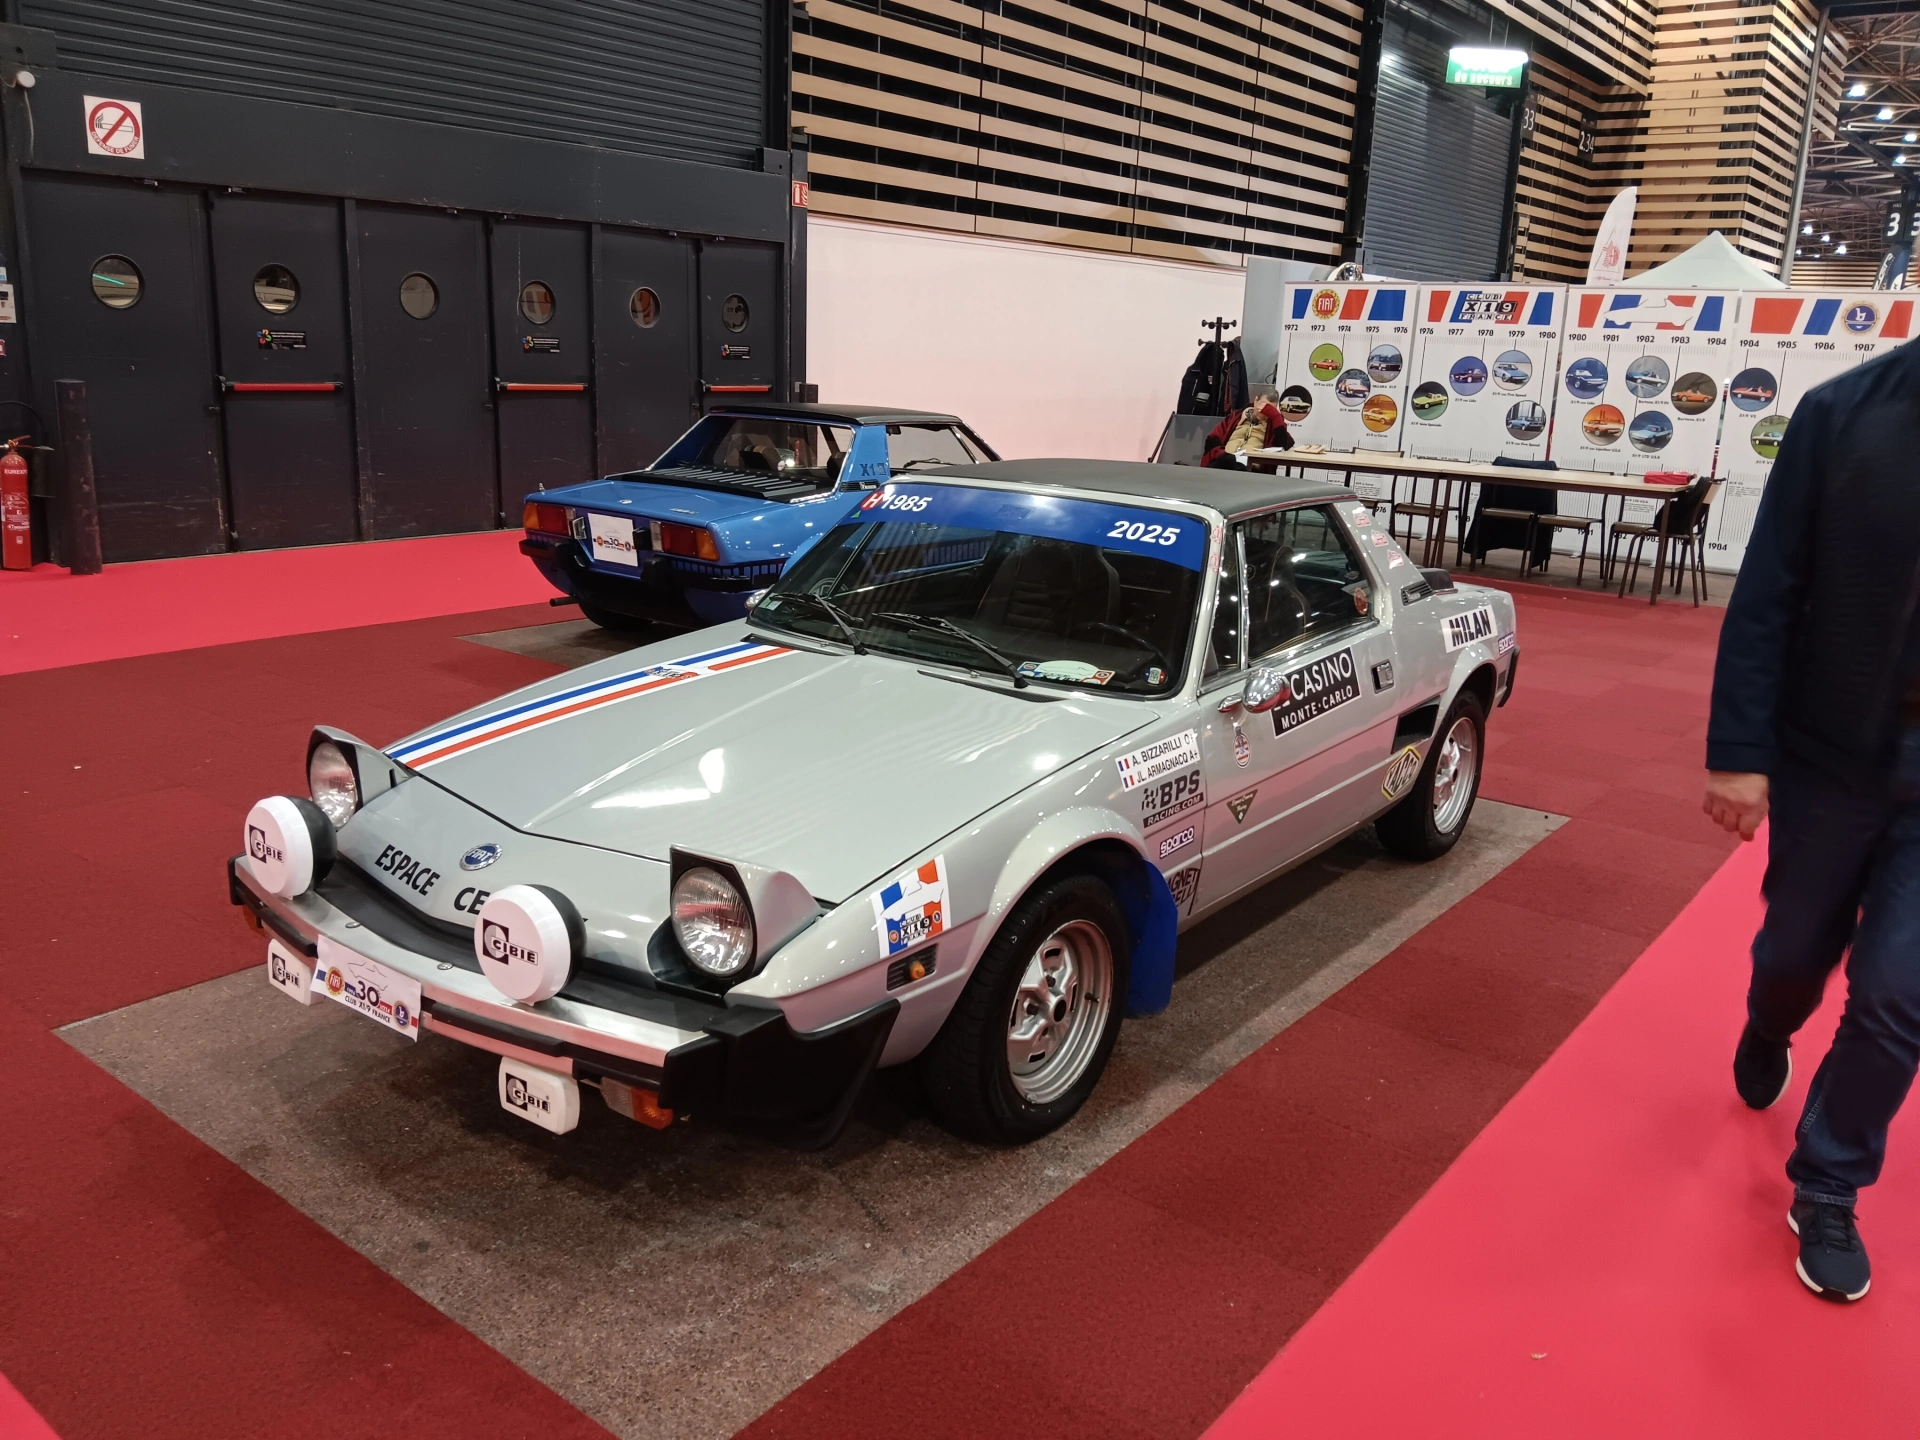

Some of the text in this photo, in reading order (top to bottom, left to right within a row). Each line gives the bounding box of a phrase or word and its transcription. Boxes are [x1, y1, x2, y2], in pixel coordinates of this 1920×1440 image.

[124, 136, 140, 153] FUMER
[1887, 212, 1900, 236] 3
[1317, 297, 1334, 311] FIAT
[1508, 330, 1525, 338] 1979
[1602, 334, 1619, 342] 1981
[1636, 335, 1655, 343] 1982
[1671, 336, 1690, 344] 1983
[1739, 339, 1875, 351] 1984 1985 1986 1987
[881, 494, 933, 512] 1985
[1106, 520, 1181, 546] 2025
[1708, 542, 1728, 551] 1984
[1449, 608, 1492, 647] MILAN
[1290, 652, 1351, 701] CASINO
[1132, 755, 1141, 767] A.
[1140, 737, 1183, 763] BIZZARILLI
[1147, 752, 1189, 778] ARMAGNACQ
[1189, 749, 1198, 761] A+
[1159, 769, 1200, 809] BPS
[1147, 795, 1201, 826] RACING.COM
[1160, 827, 1194, 856] sparco
[468, 849, 494, 861] FIAT
[374, 844, 441, 896] ESPACE
[356, 980, 380, 1007] 30
[344, 995, 357, 1006] CLUB
[372, 1009, 391, 1023] FRANCE
